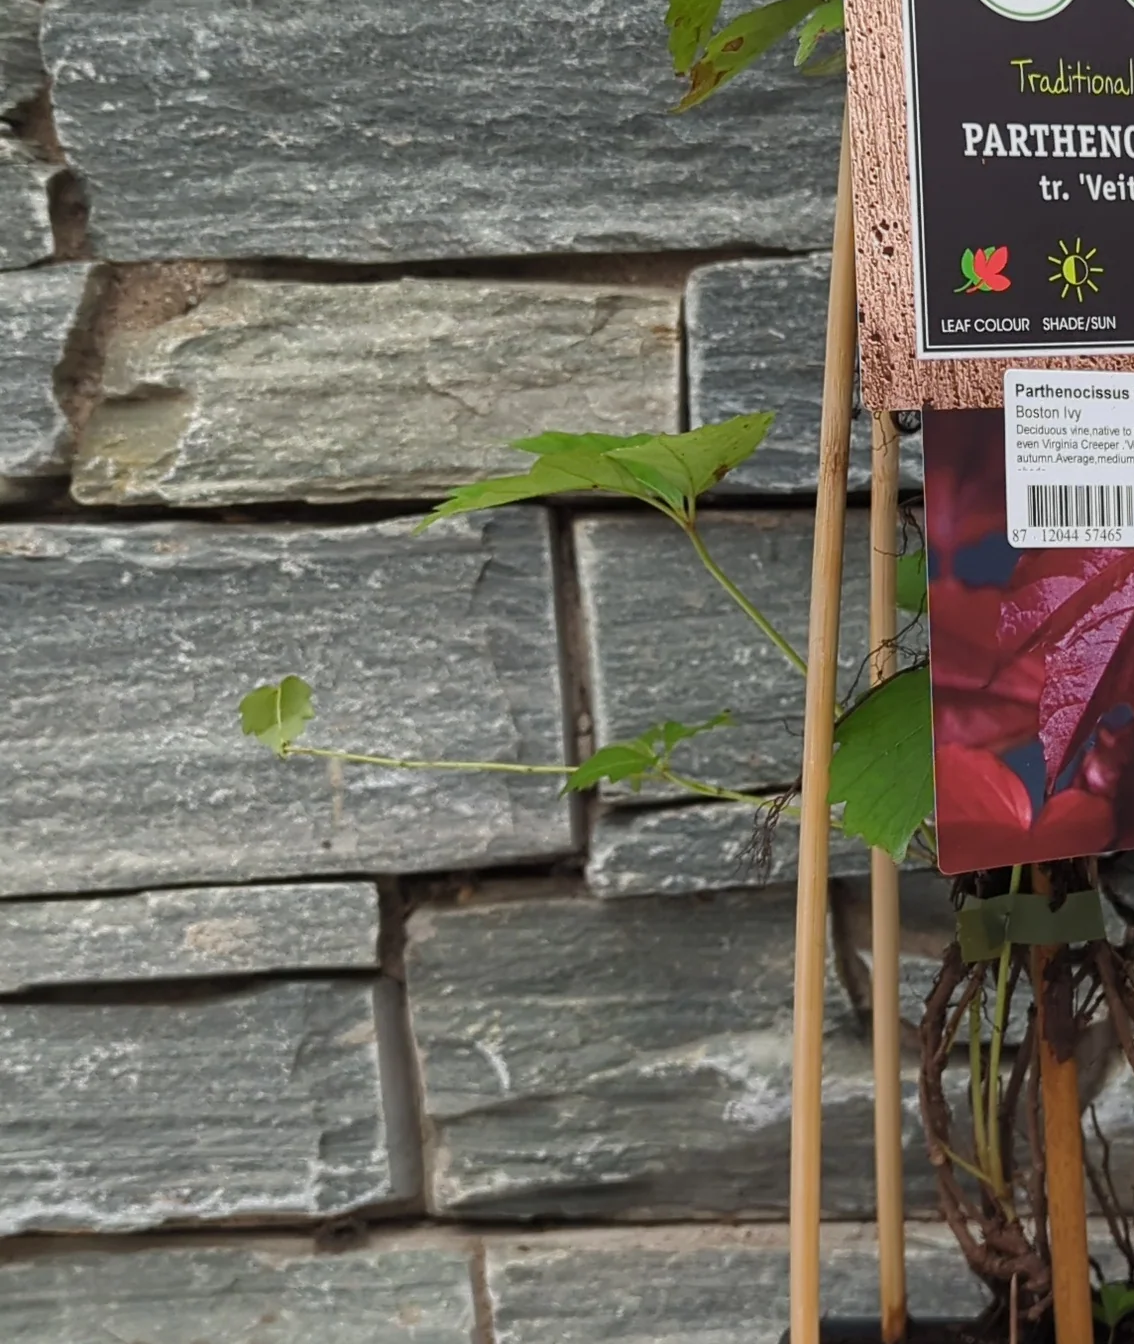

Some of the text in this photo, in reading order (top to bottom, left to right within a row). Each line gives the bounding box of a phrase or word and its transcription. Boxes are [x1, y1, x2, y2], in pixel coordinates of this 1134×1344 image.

[1010, 57, 1134, 96] Traditional
[1039, 174, 1071, 201] tr.
[941, 317, 1031, 333] LEAF COLOUR
[1042, 315, 1117, 332] SHADE/SUN
[1015, 383, 1130, 400] Parthenocissus
[1016, 405, 1082, 422] Boston Ivy
[1016, 424, 1067, 435] Deciduous
[1122, 425, 1131, 436] to
[1016, 439, 1039, 449] even
[1042, 439, 1078, 452] Virginia
[1080, 439, 1119, 452] Creeper
[1012, 529, 1027, 542] 87
[1042, 528, 1078, 542] 12044
[1085, 528, 1122, 542] 57465
